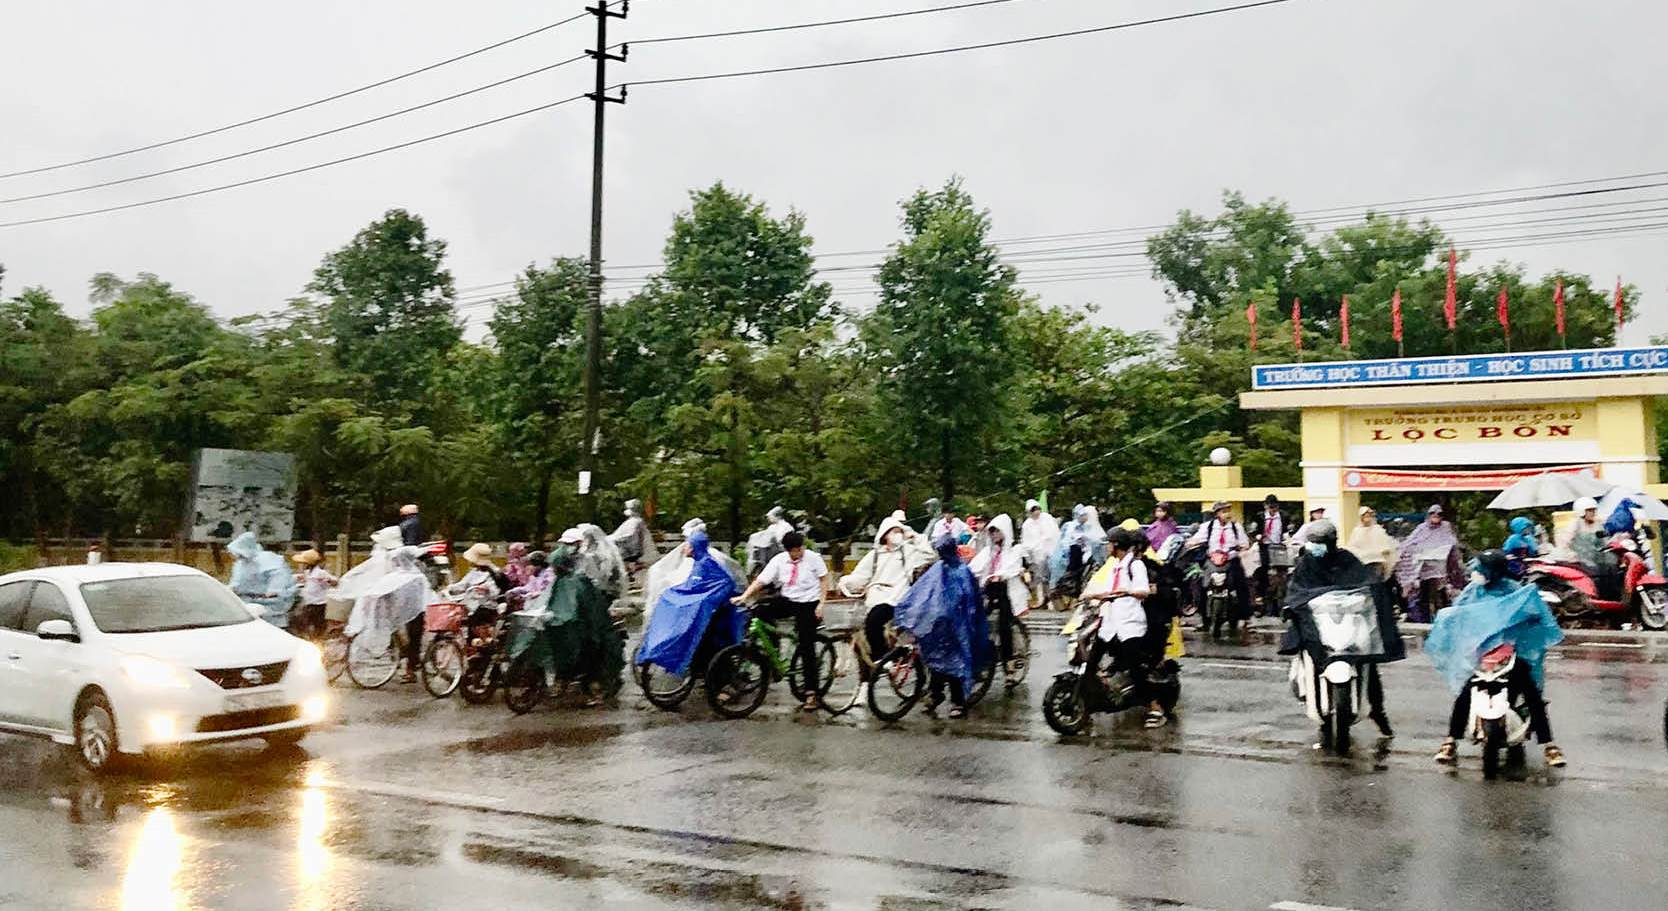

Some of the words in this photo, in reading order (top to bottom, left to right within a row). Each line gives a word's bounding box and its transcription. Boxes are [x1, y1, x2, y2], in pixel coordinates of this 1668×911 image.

[1327, 366, 1361, 382] HỌC
[1488, 358, 1525, 376] HỌC
[1529, 356, 1573, 371] SINH
[1578, 350, 1624, 370] TÍCH
[1431, 413, 1488, 424] TRUNG
[1371, 426, 1459, 443] LỘC
